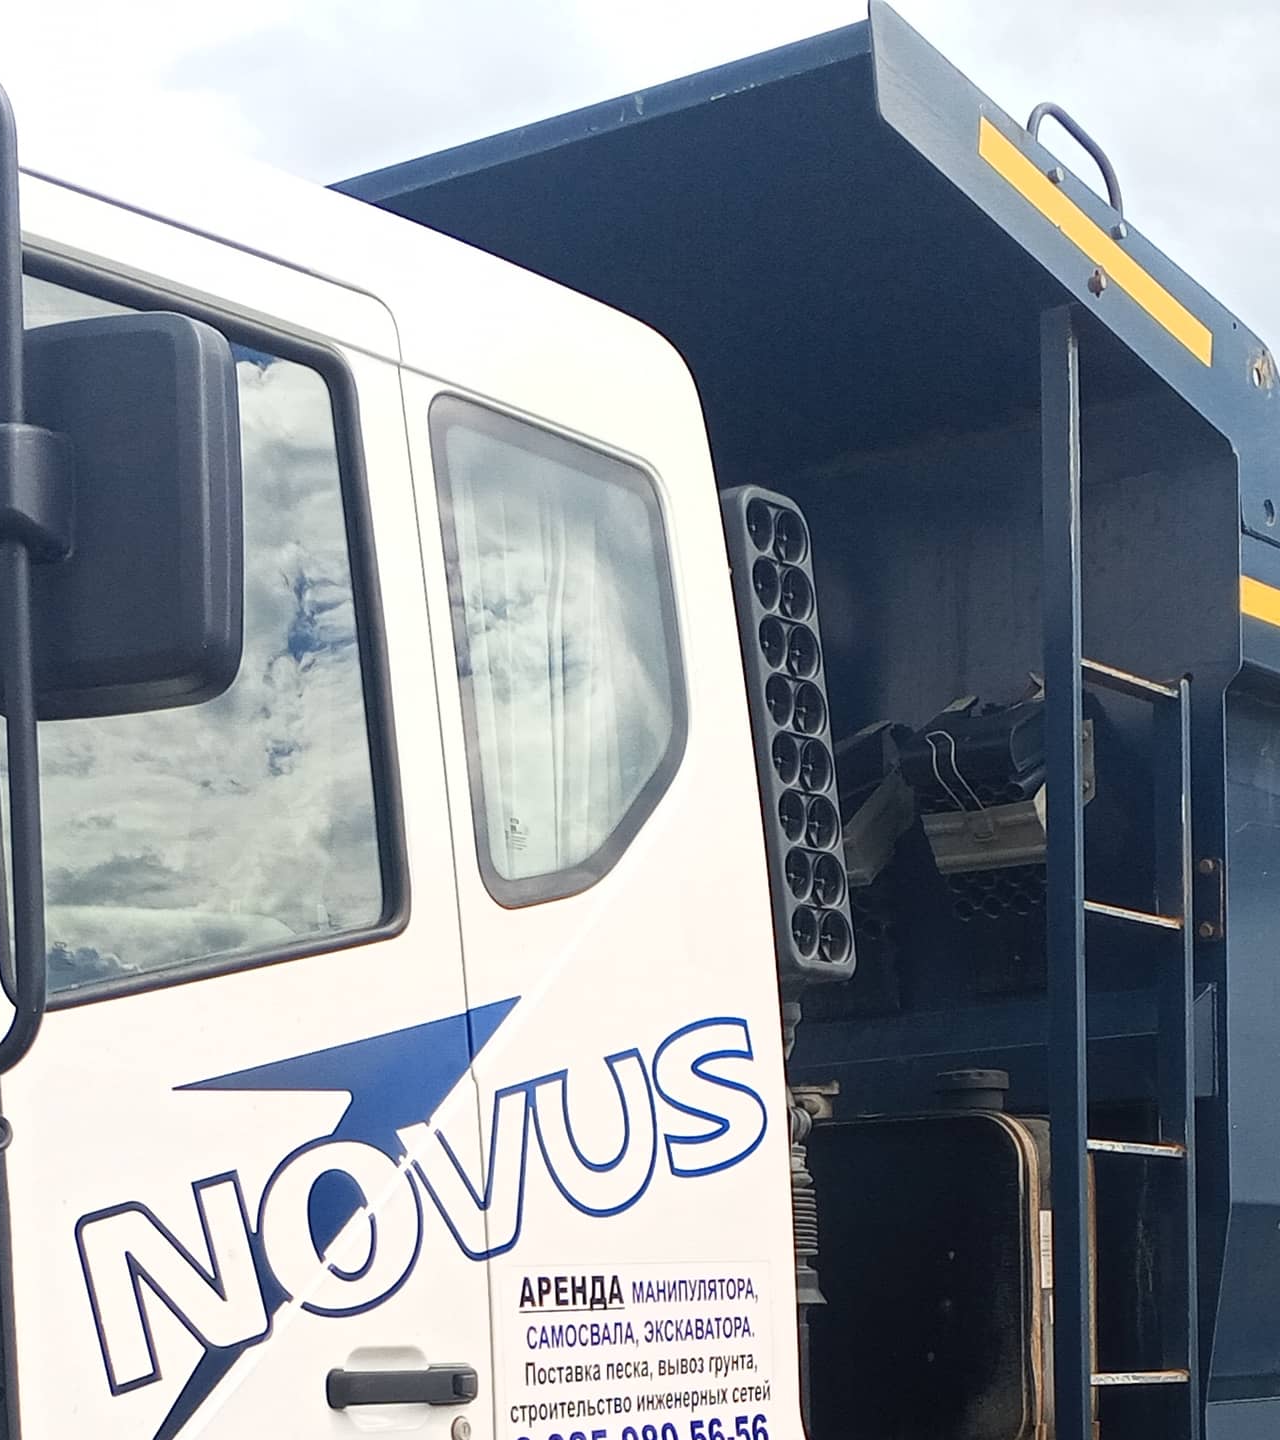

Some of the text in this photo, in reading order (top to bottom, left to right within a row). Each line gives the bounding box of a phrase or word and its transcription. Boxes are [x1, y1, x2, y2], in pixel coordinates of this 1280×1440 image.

[74, 1017, 768, 1397] NOVUS
[519, 1275, 758, 1311] АРЕНДА МАНИПУЛЯТОРА,
[526, 1322, 639, 1349] САМОСВАЛА,
[525, 1353, 758, 1386] Поставка песка, вывоз грунта,
[510, 1380, 771, 1427] строительство инженерных сетей
